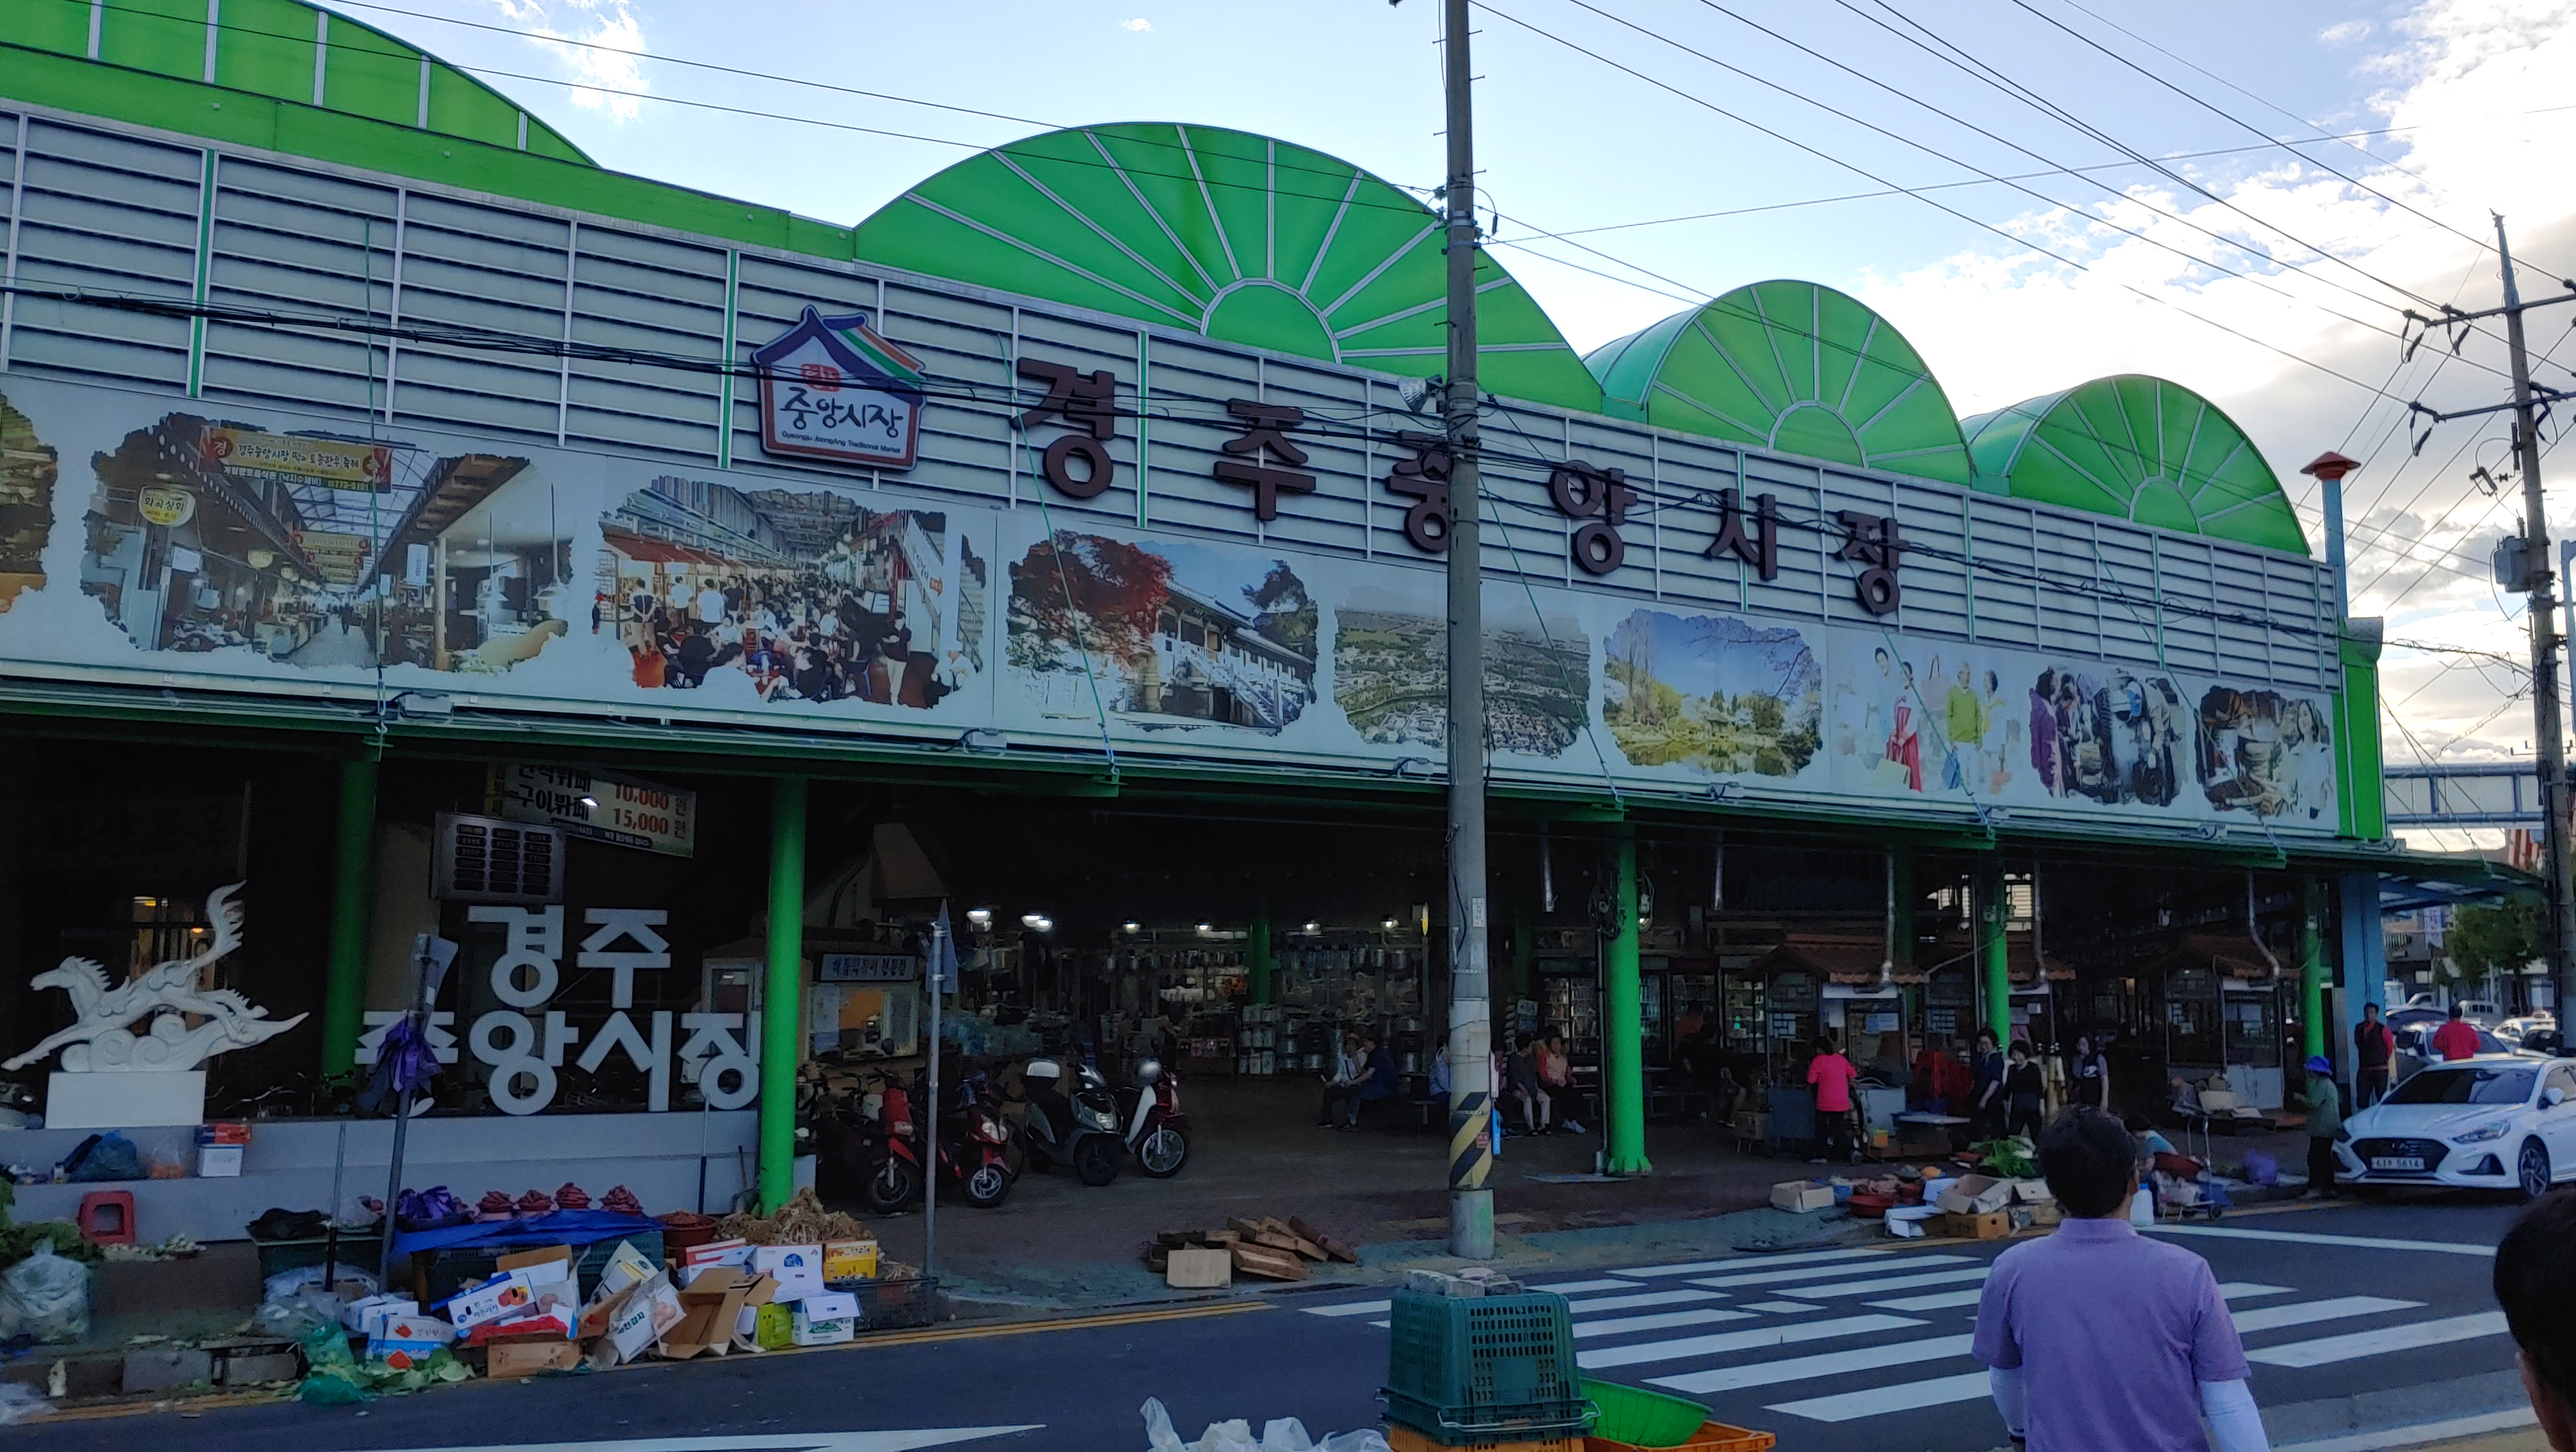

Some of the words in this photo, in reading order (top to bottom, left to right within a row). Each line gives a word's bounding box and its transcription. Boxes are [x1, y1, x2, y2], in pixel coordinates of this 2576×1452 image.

[779, 387, 903, 438] 중앙시장
[781, 430, 813, 442] Gyeongju
[814, 435, 846, 447] JoongAng
[847, 439, 879, 451] Traditional
[880, 444, 901, 454] Market
[238, 444, 289, 461] 경주중앙시장
[309, 454, 341, 467] 토종한우
[343, 456, 359, 470] 축제
[613, 808, 669, 835] 15,000
[467, 904, 671, 1008] 경주
